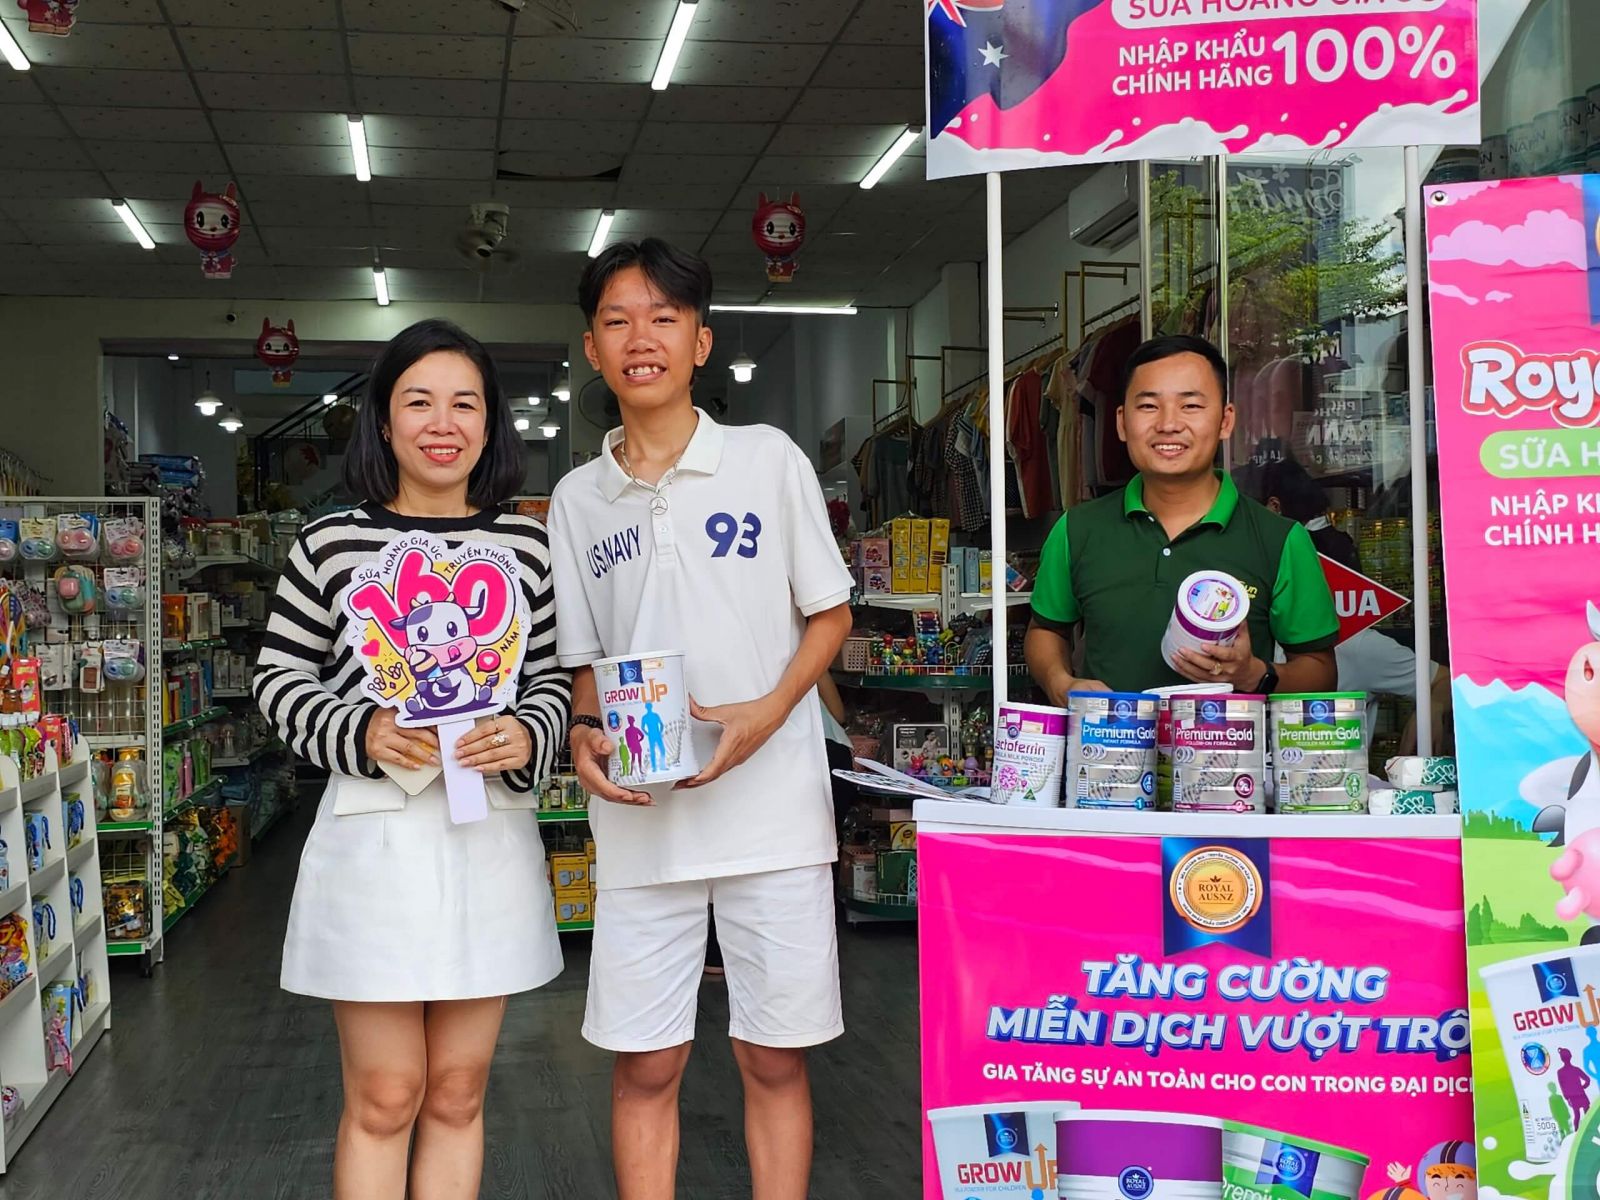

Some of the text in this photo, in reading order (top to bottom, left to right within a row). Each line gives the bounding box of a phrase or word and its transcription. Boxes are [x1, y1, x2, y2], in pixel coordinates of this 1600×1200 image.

[1119, 28, 1265, 69] NHẬP KHẨU
[1271, 25, 1456, 85] 100%
[1112, 63, 1272, 96] CHÍNH HÃNG
[1466, 346, 1600, 420] Roy
[1499, 438, 1571, 470] SỮA
[1490, 488, 1569, 520] NHẬP
[705, 511, 762, 559] 93
[1484, 519, 1574, 546] CHÍNH
[358, 537, 443, 582] SỮA HOÀNG GIA ÚC
[484, 548, 516, 575] THỐNG
[500, 631, 520, 653] NĂM
[604, 687, 639, 704] GROW
[1082, 725, 1134, 739] Premium
[1137, 726, 1156, 740] Gold
[1176, 727, 1223, 741] Premium
[1226, 727, 1253, 741] Gold
[1280, 727, 1360, 741] Premium Gold
[995, 740, 1046, 756] actoferrin
[1198, 883, 1234, 892] ROYAL
[1198, 893, 1234, 901] AUSNZ
[1082, 954, 1389, 1001] TĂNG CƯỜNG
[987, 995, 1470, 1057] MIỄN DỊCH VƯỢT TRỘ
[1513, 1003, 1574, 1032] GROW
[982, 1063, 1018, 1081] GIA
[1021, 1062, 1076, 1083] TĂNG
[1081, 1067, 1110, 1089] SỰ
[1112, 1069, 1143, 1087] AN
[1147, 1067, 1206, 1089] TOÀN
[1211, 1073, 1256, 1091] CHO
[1261, 1074, 1306, 1092] CON
[1311, 1075, 1386, 1093] TRONG
[1391, 1076, 1427, 1098] ĐẠI
[957, 1161, 1022, 1184] GROW
